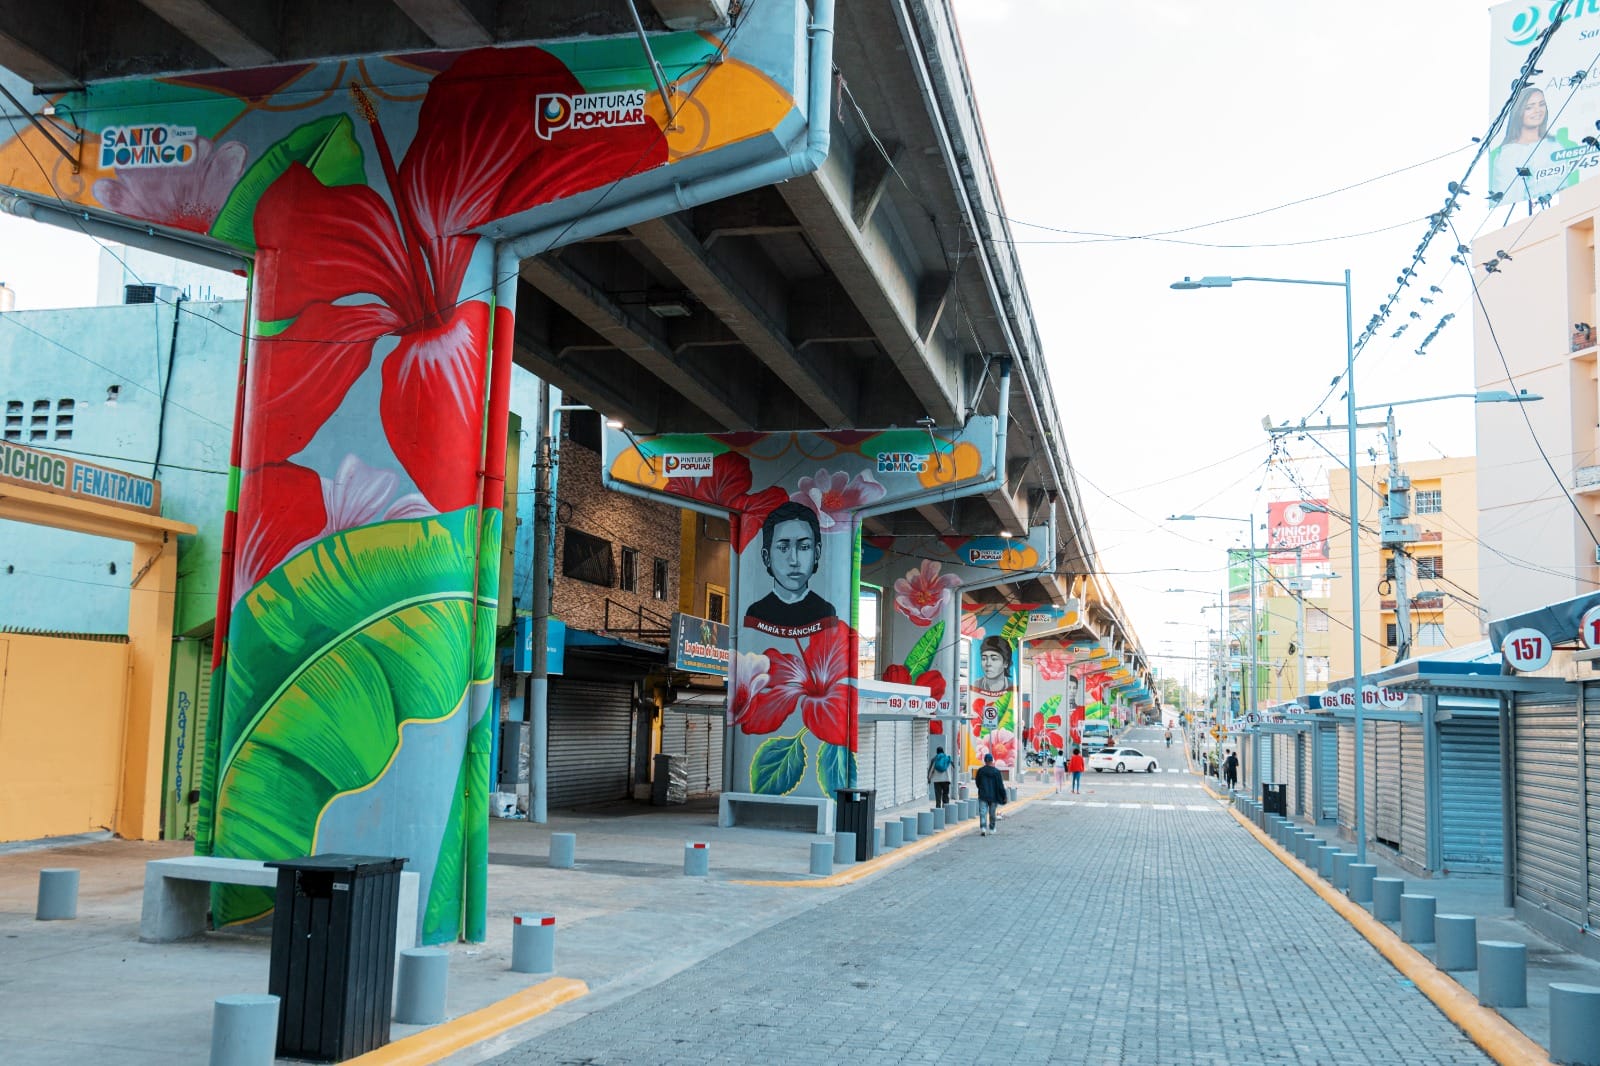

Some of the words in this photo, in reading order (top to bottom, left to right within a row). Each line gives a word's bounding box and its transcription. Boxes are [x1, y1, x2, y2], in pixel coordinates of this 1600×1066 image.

[574, 93, 644, 110] PINTURAS
[573, 108, 643, 127] POPULAR
[103, 127, 168, 148] SANTO
[102, 144, 193, 166] DOMINGO
[1536, 165, 1565, 180] (829)
[680, 456, 711, 464] PINTURAS
[878, 453, 914, 463] SANTO
[680, 463, 711, 471] POPULAR
[878, 461, 927, 471] DOMINGO
[73, 464, 153, 507] FENATRANO
[1272, 524, 1321, 538] VINICIO
[757, 622, 779, 634] MARÍA
[788, 622, 822, 636] SÁNCHEZ
[1511, 637, 1542, 660] 157
[889, 698, 902, 708] 193
[908, 699, 919, 708] 191
[1323, 696, 1338, 707] 165
[1361, 691, 1379, 704] 161
[925, 700, 936, 709] 189
[940, 701, 950, 709] 187
